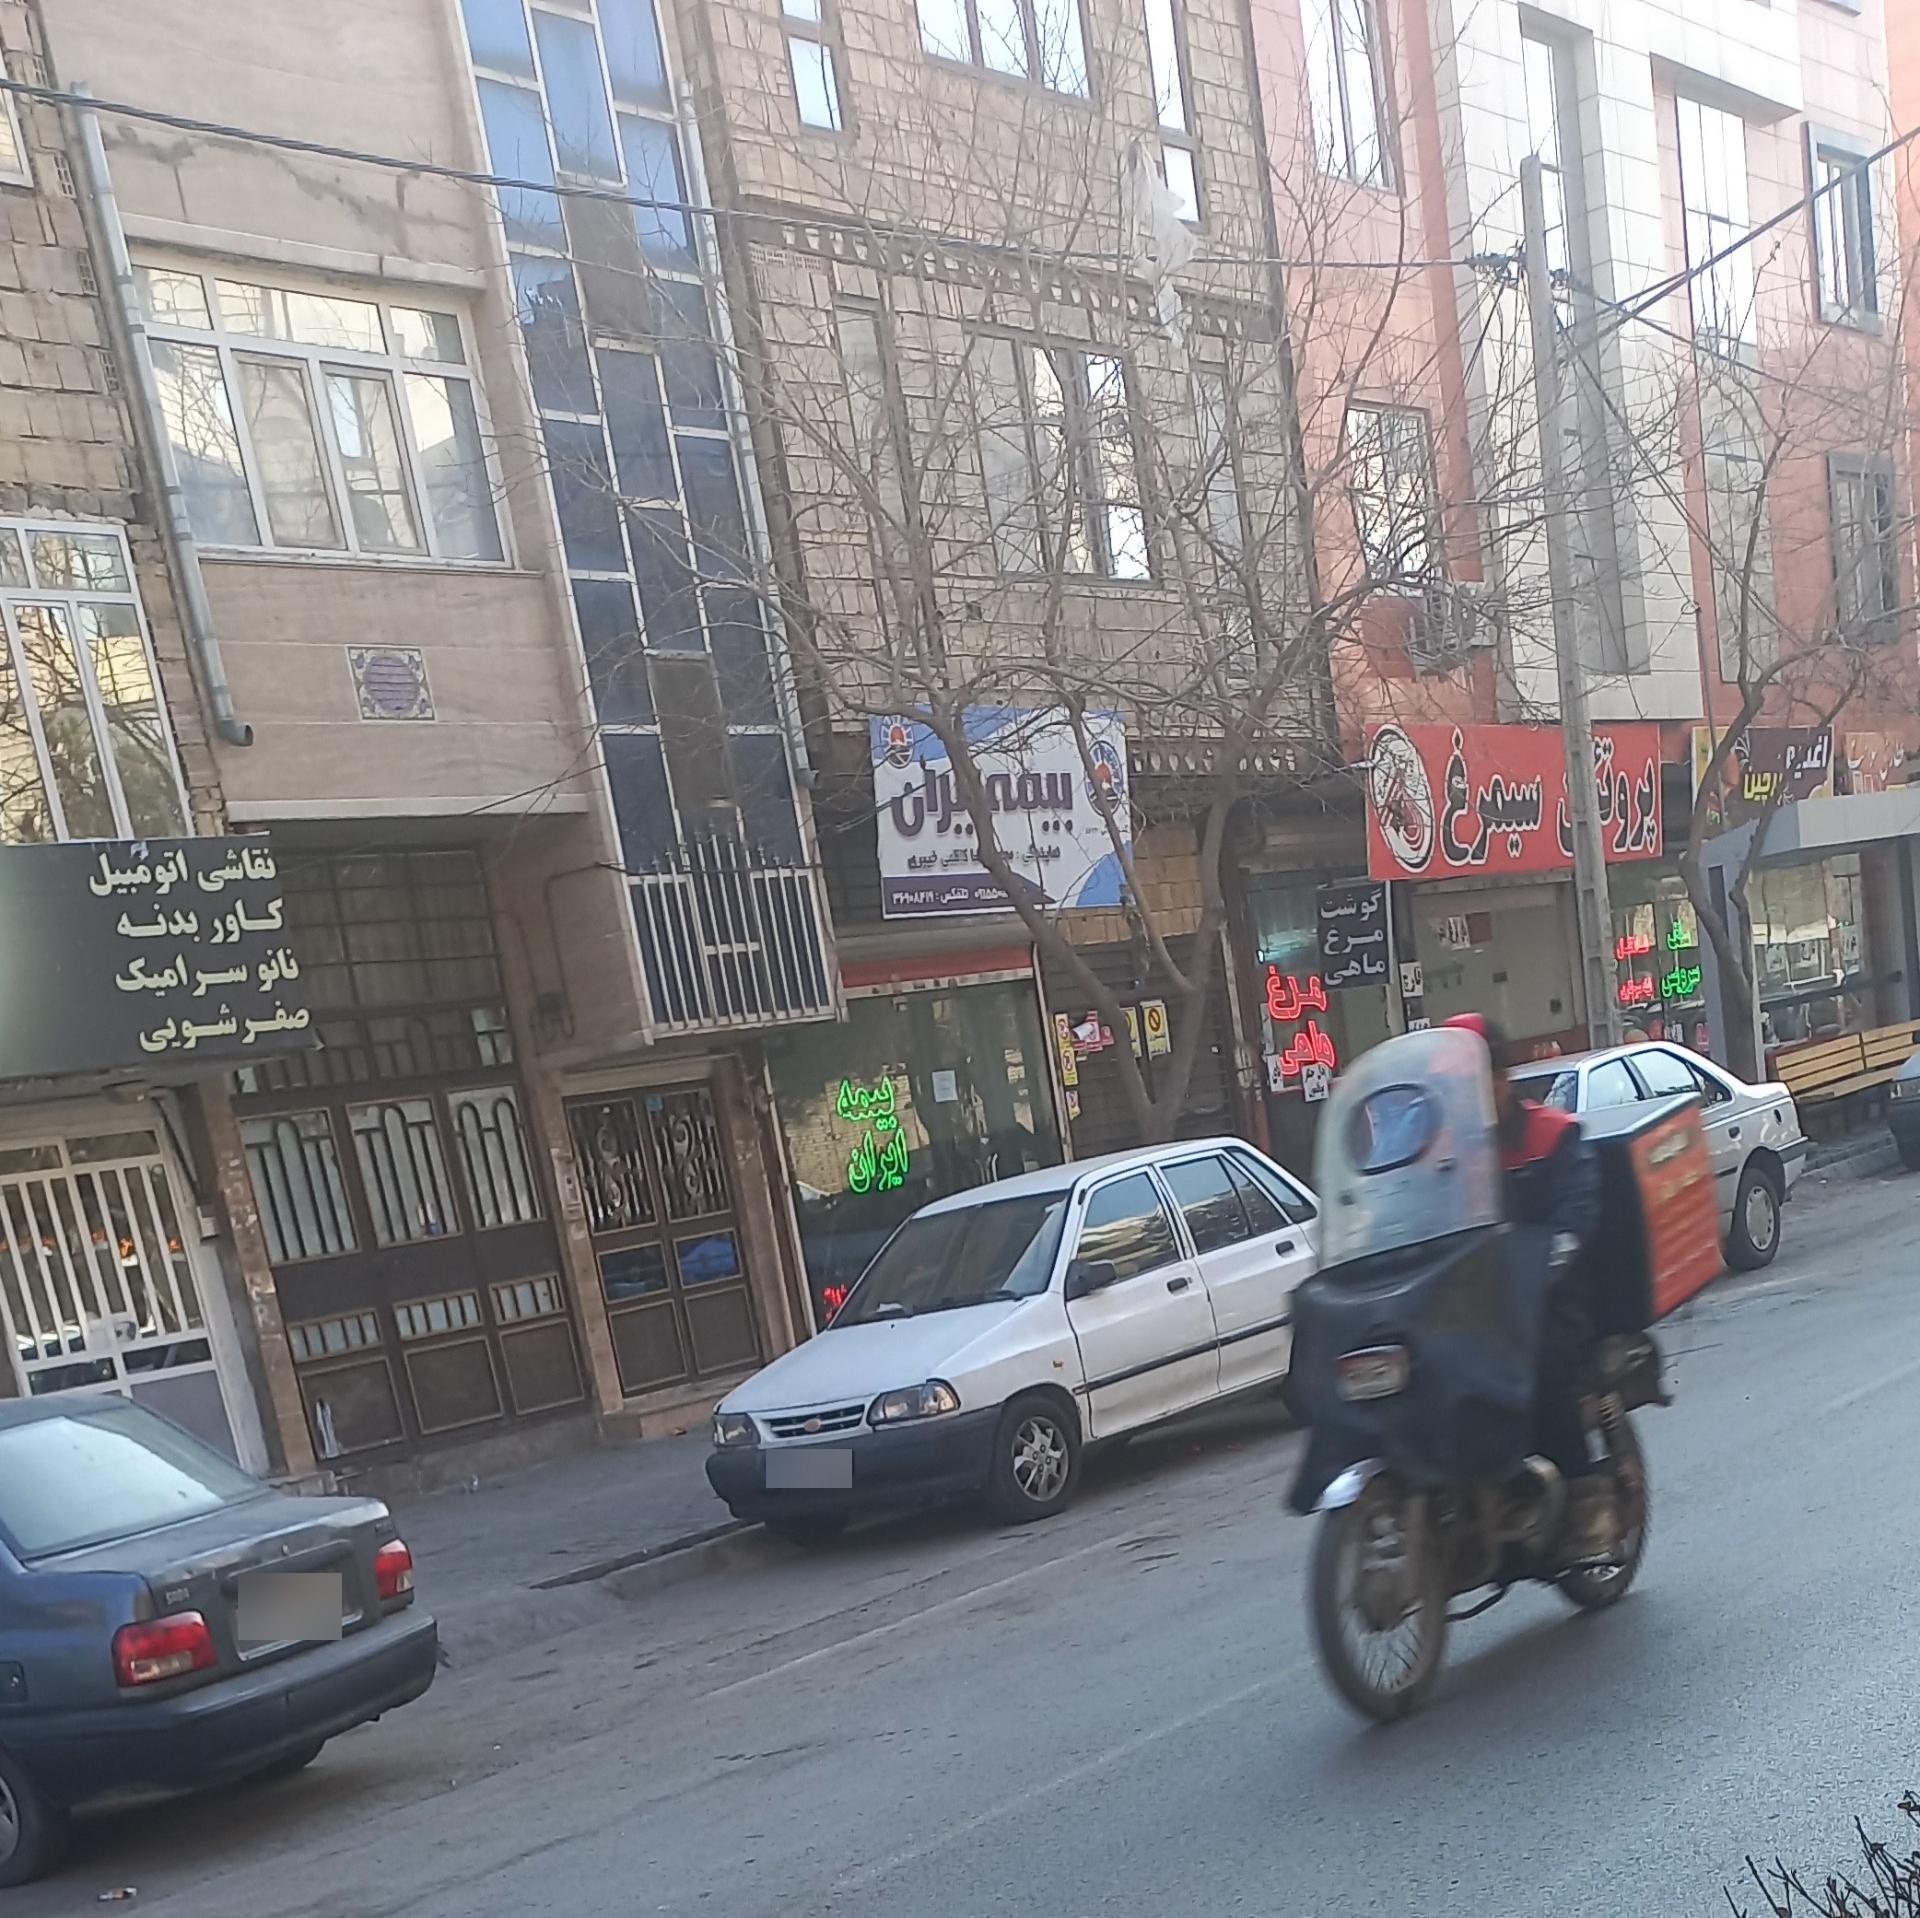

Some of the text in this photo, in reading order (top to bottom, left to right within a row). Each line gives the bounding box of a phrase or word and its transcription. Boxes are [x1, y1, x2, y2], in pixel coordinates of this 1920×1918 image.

[1440, 725, 1543, 866] سیمرغ
[88, 847, 278, 896] نقاشی اتومبیل
[116, 898, 284, 943] کاور بدنه
[1320, 888, 1382, 921] گوشت
[1323, 924, 1384, 955] مرغ
[257, 947, 300, 992] نانو
[1266, 965, 1328, 1019] مرغ
[1324, 952, 1387, 986] ماهی
[1279, 1020, 1335, 1075] ماهی
[837, 1075, 897, 1129] بیمه
[848, 1127, 909, 1193] ایران
